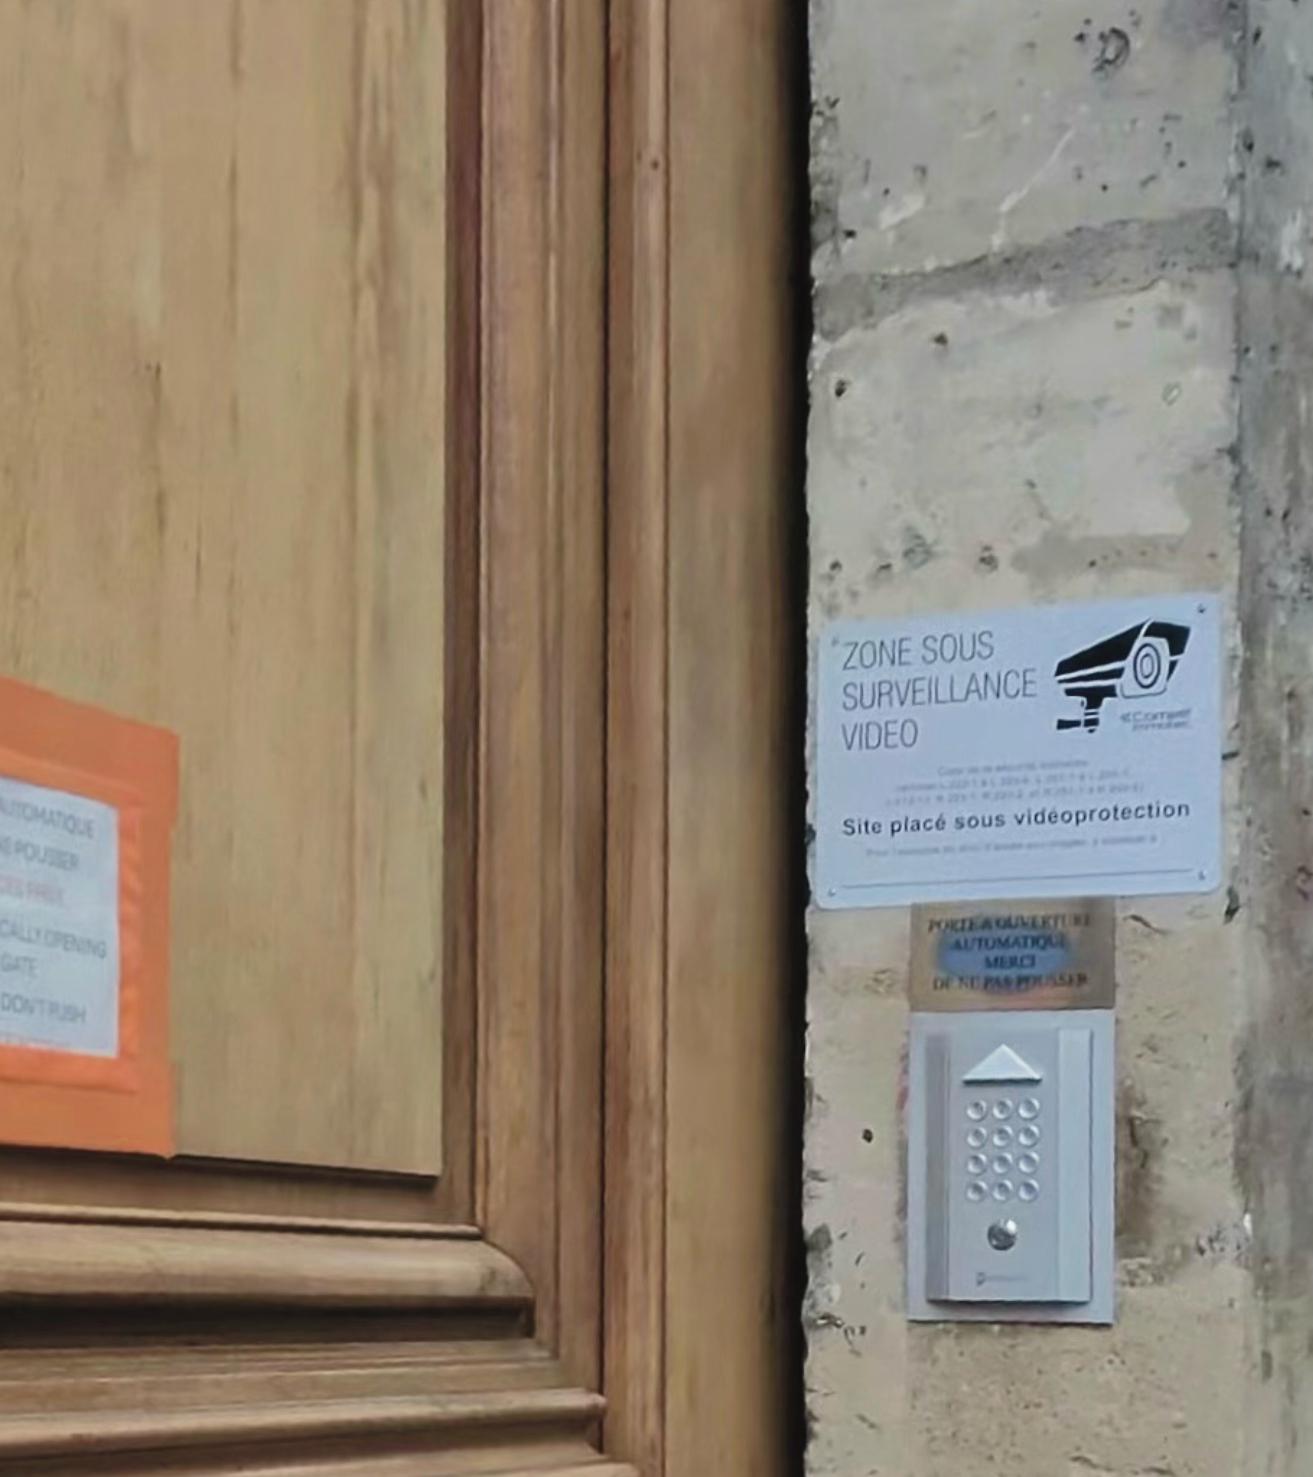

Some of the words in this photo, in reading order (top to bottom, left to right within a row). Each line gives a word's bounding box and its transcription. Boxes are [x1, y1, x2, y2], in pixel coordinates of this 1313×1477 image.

[841, 636, 913, 672] ZONE
[920, 629, 995, 665] SOUS
[841, 667, 1038, 712] SURVEILLANCE
[841, 718, 919, 751] VIDEO
[841, 816, 883, 837] Site
[889, 812, 947, 839] placé
[954, 812, 1007, 831] sous
[1013, 799, 1191, 827] vidéoprotection
[928, 916, 975, 933] PORTE
[43, 926, 107, 960] OPENING
[952, 932, 1067, 951] AUTOMATIQUE
[0, 951, 38, 977] GATE
[984, 954, 1037, 969] MERCI
